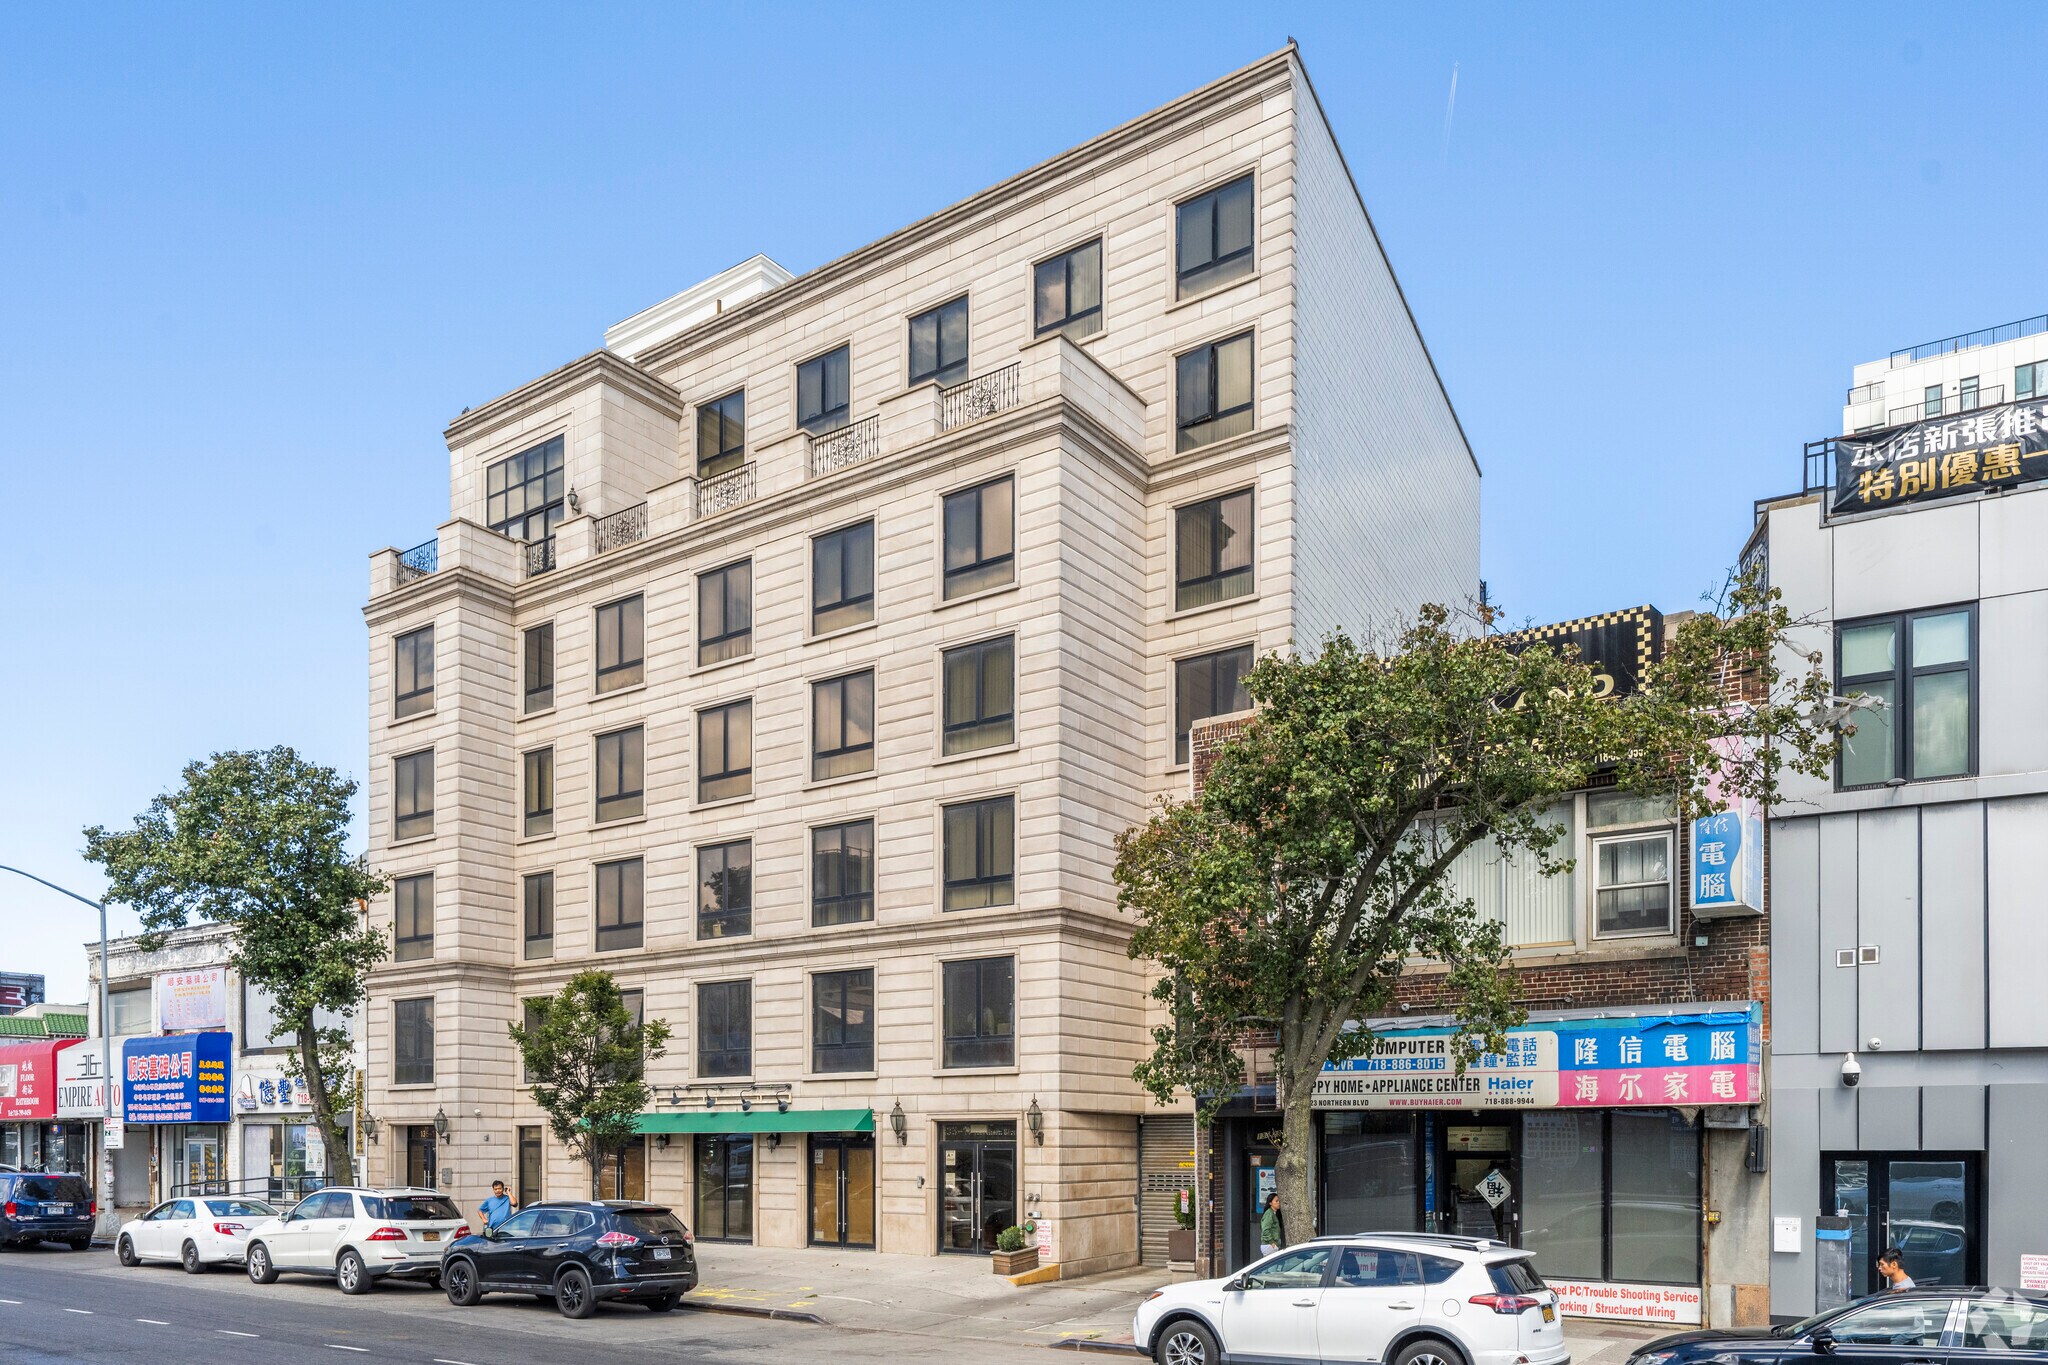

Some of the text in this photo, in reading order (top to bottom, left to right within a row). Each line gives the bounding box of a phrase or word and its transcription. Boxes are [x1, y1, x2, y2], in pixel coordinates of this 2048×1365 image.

[1851, 405, 2048, 467] 本店新張推
[1699, 841, 1727, 899] 電腦
[1575, 1030, 1736, 1065] 隆信電腦
[1367, 1058, 1445, 1070] 718-886-8015
[1311, 1080, 1331, 1093] PPY
[1437, 1077, 1481, 1092] CENTER
[1488, 1077, 1534, 1090] Haier
[1575, 1070, 1736, 1102] 海尔家電
[59, 1086, 92, 1108] EMPIRE
[1319, 1099, 1351, 1107] NORTHERN
[1389, 1098, 1462, 1106] WWW.BUYHAIER.COM
[1485, 1097, 1535, 1105] 718-888-9944
[1570, 1286, 1618, 1298] PC/Trouble
[1620, 1288, 1661, 1303] Shooting
[1663, 1292, 1699, 1303] Service
[1560, 1301, 1588, 1314] orking
[1595, 1303, 1643, 1316] Structured
[1645, 1307, 1676, 1320] Wiring
